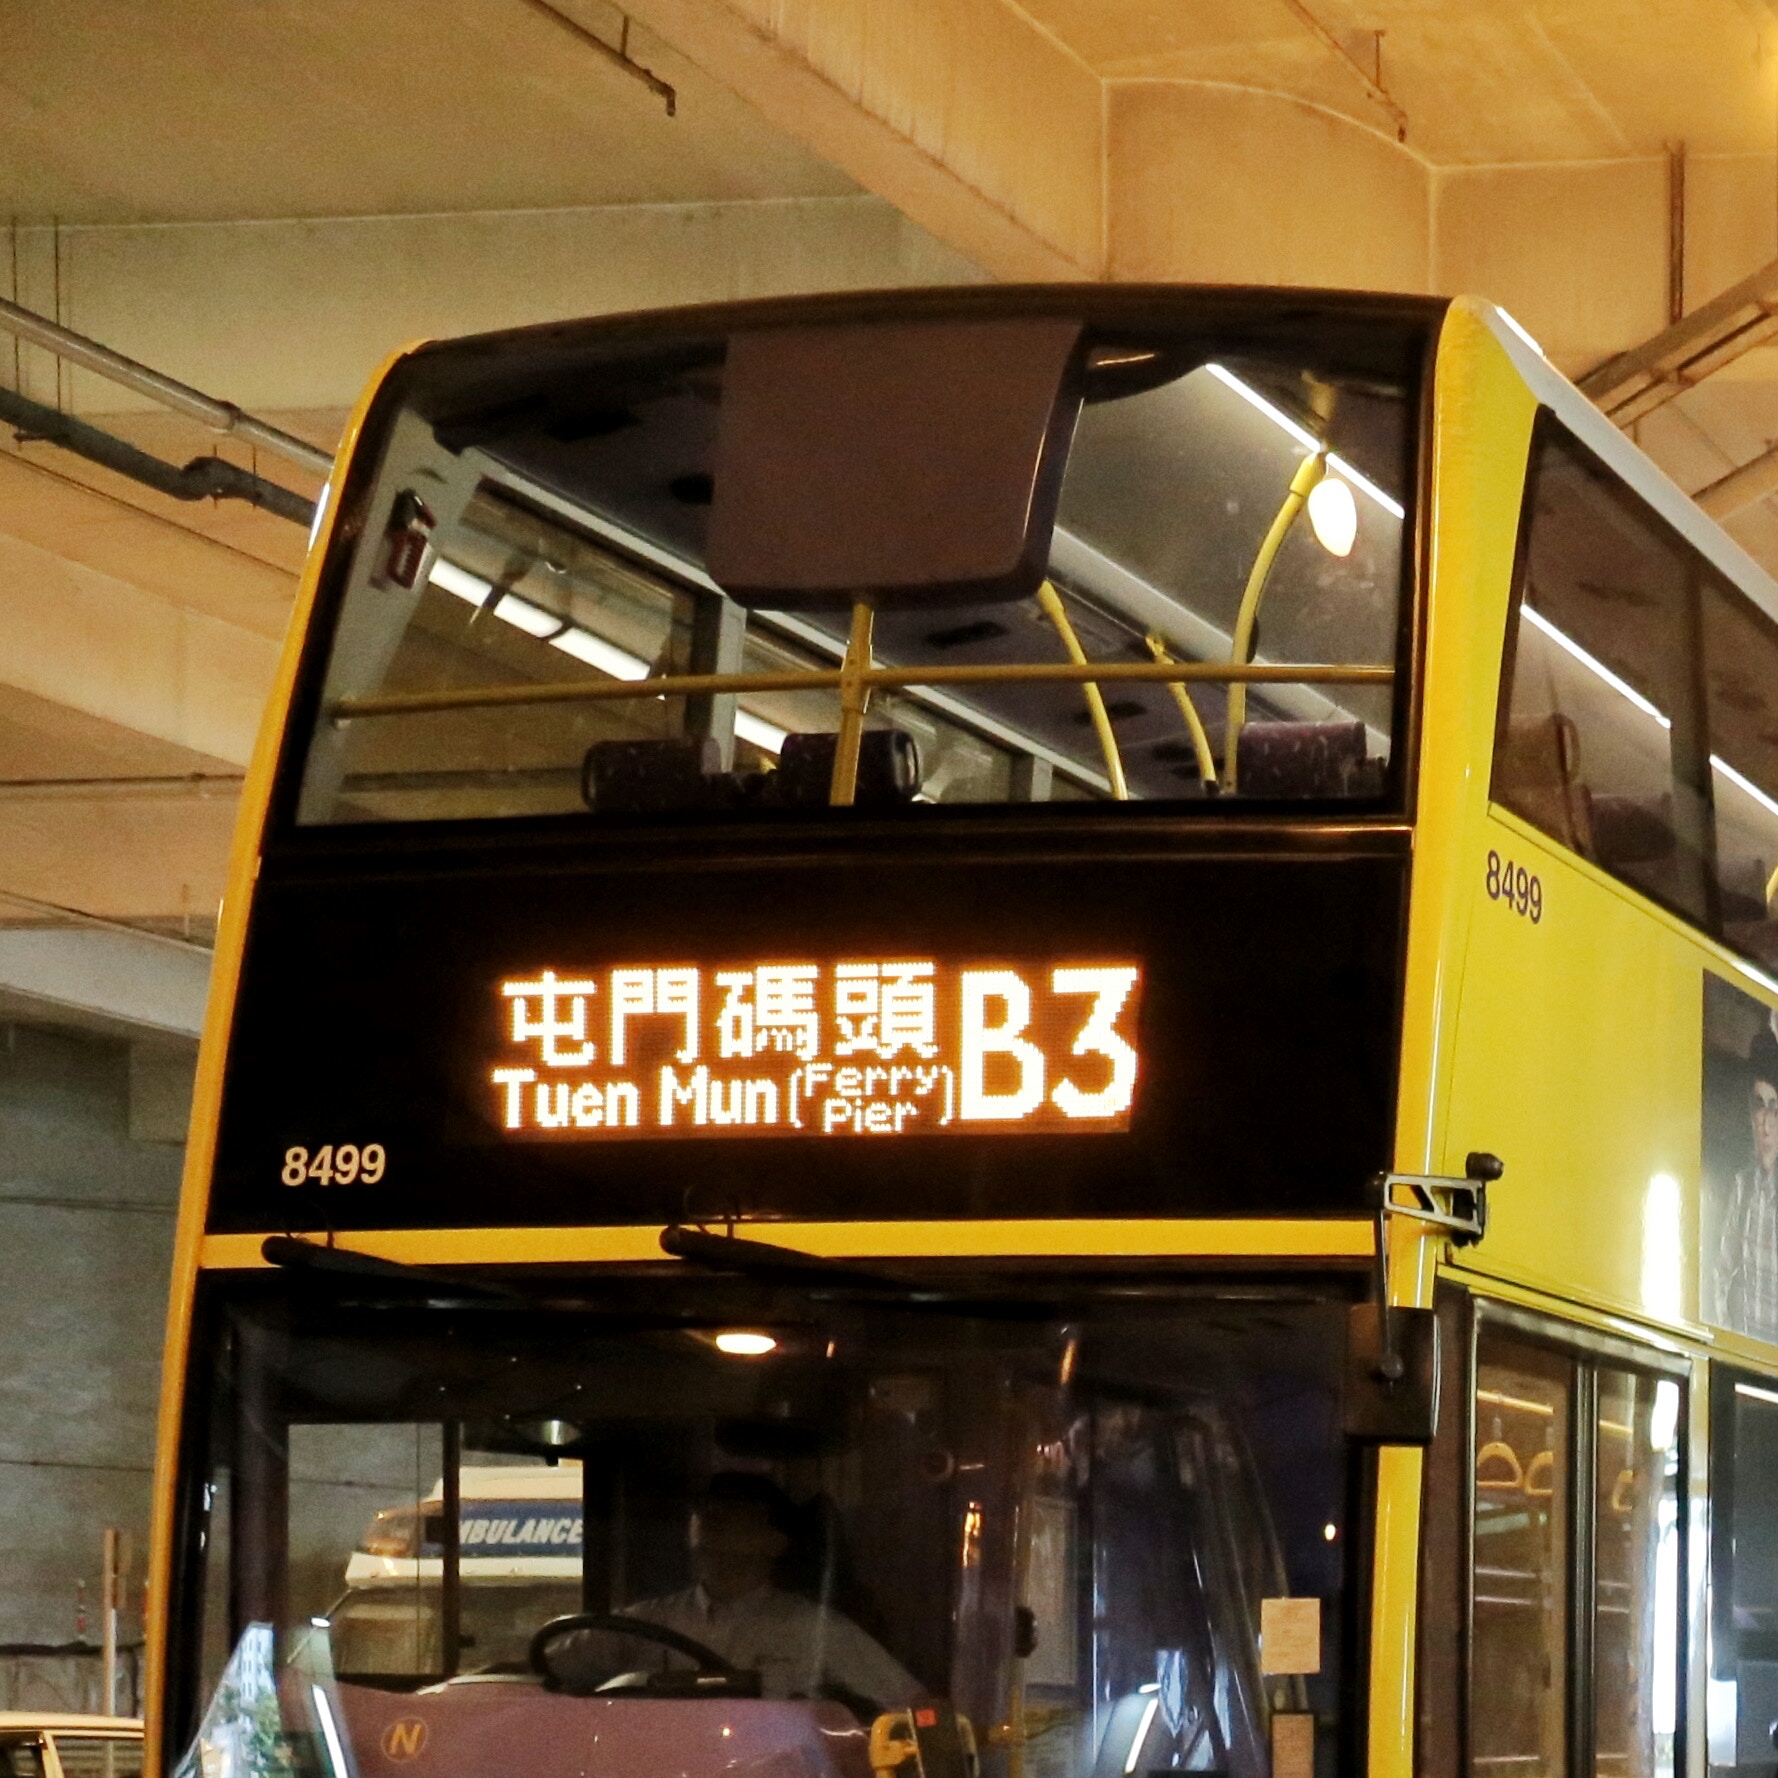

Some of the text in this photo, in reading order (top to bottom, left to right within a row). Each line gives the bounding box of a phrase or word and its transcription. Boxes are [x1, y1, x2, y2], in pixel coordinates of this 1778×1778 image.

[1486, 849, 1542, 925] 8499
[503, 964, 939, 1068] 屯門碼頭
[961, 968, 1137, 1120] B3
[493, 1068, 640, 1129] Tuen
[660, 1065, 780, 1126] Mun
[281, 1143, 386, 1186] 8499
